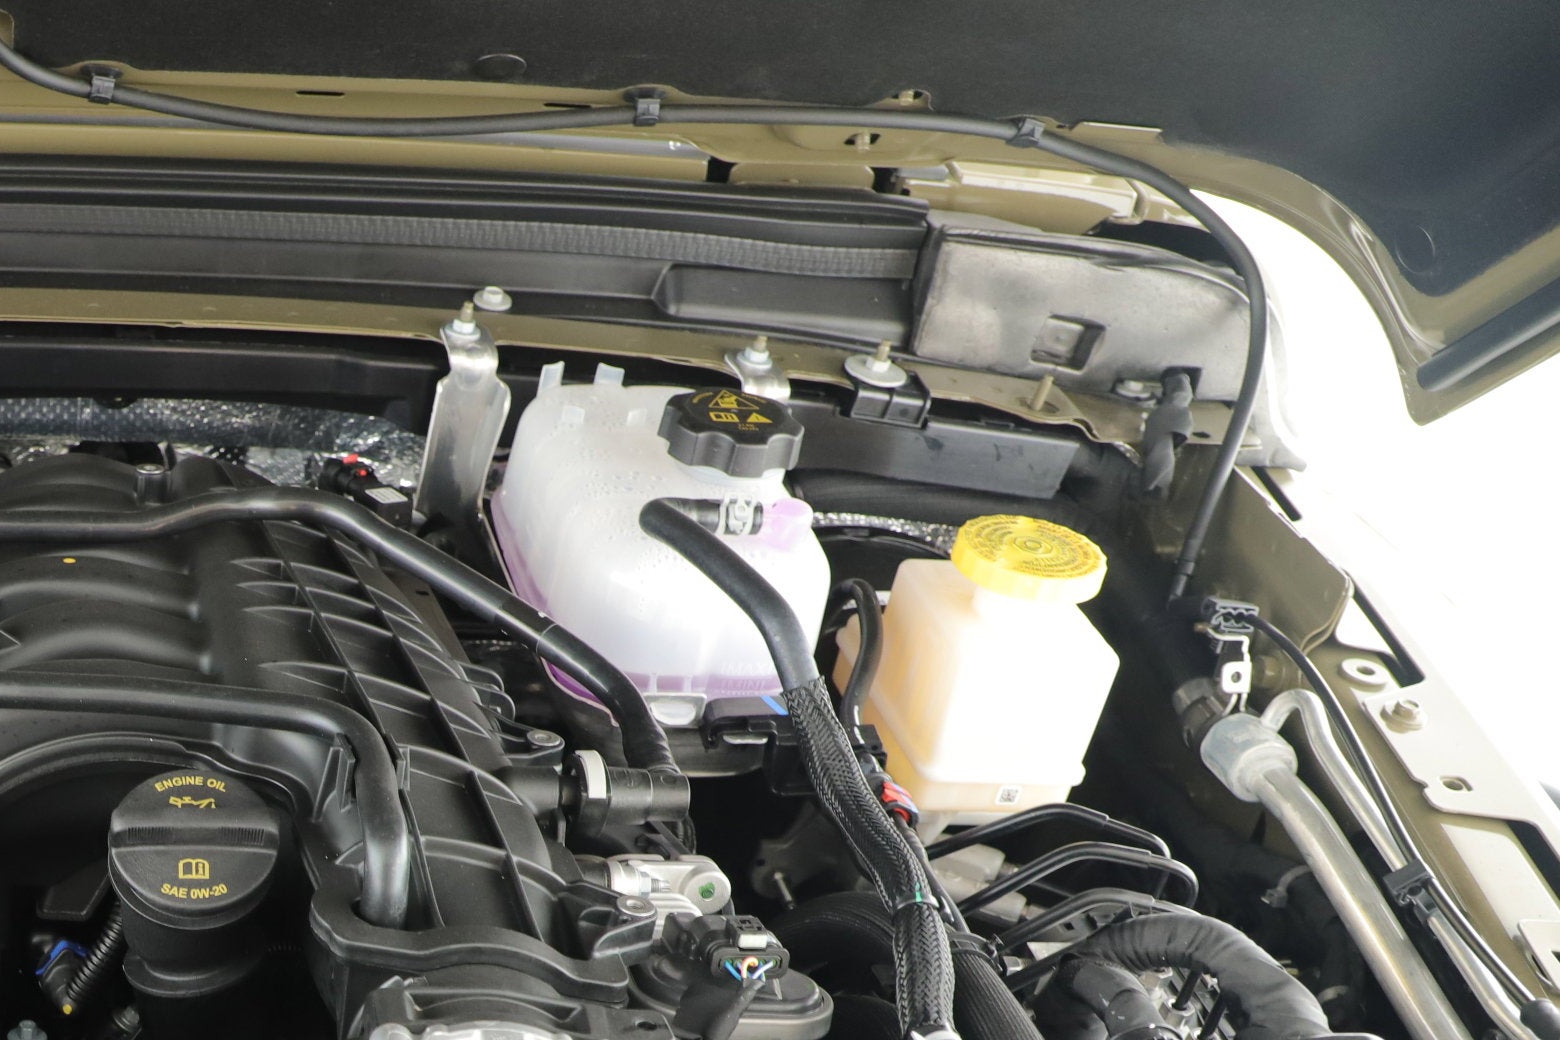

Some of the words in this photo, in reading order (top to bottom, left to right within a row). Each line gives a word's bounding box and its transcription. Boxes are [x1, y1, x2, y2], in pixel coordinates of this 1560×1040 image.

[154, 775, 204, 792] ENGINE
[206, 778, 227, 793] OIL
[160, 883, 188, 898] SAE
[190, 883, 228, 899] 0W-20
